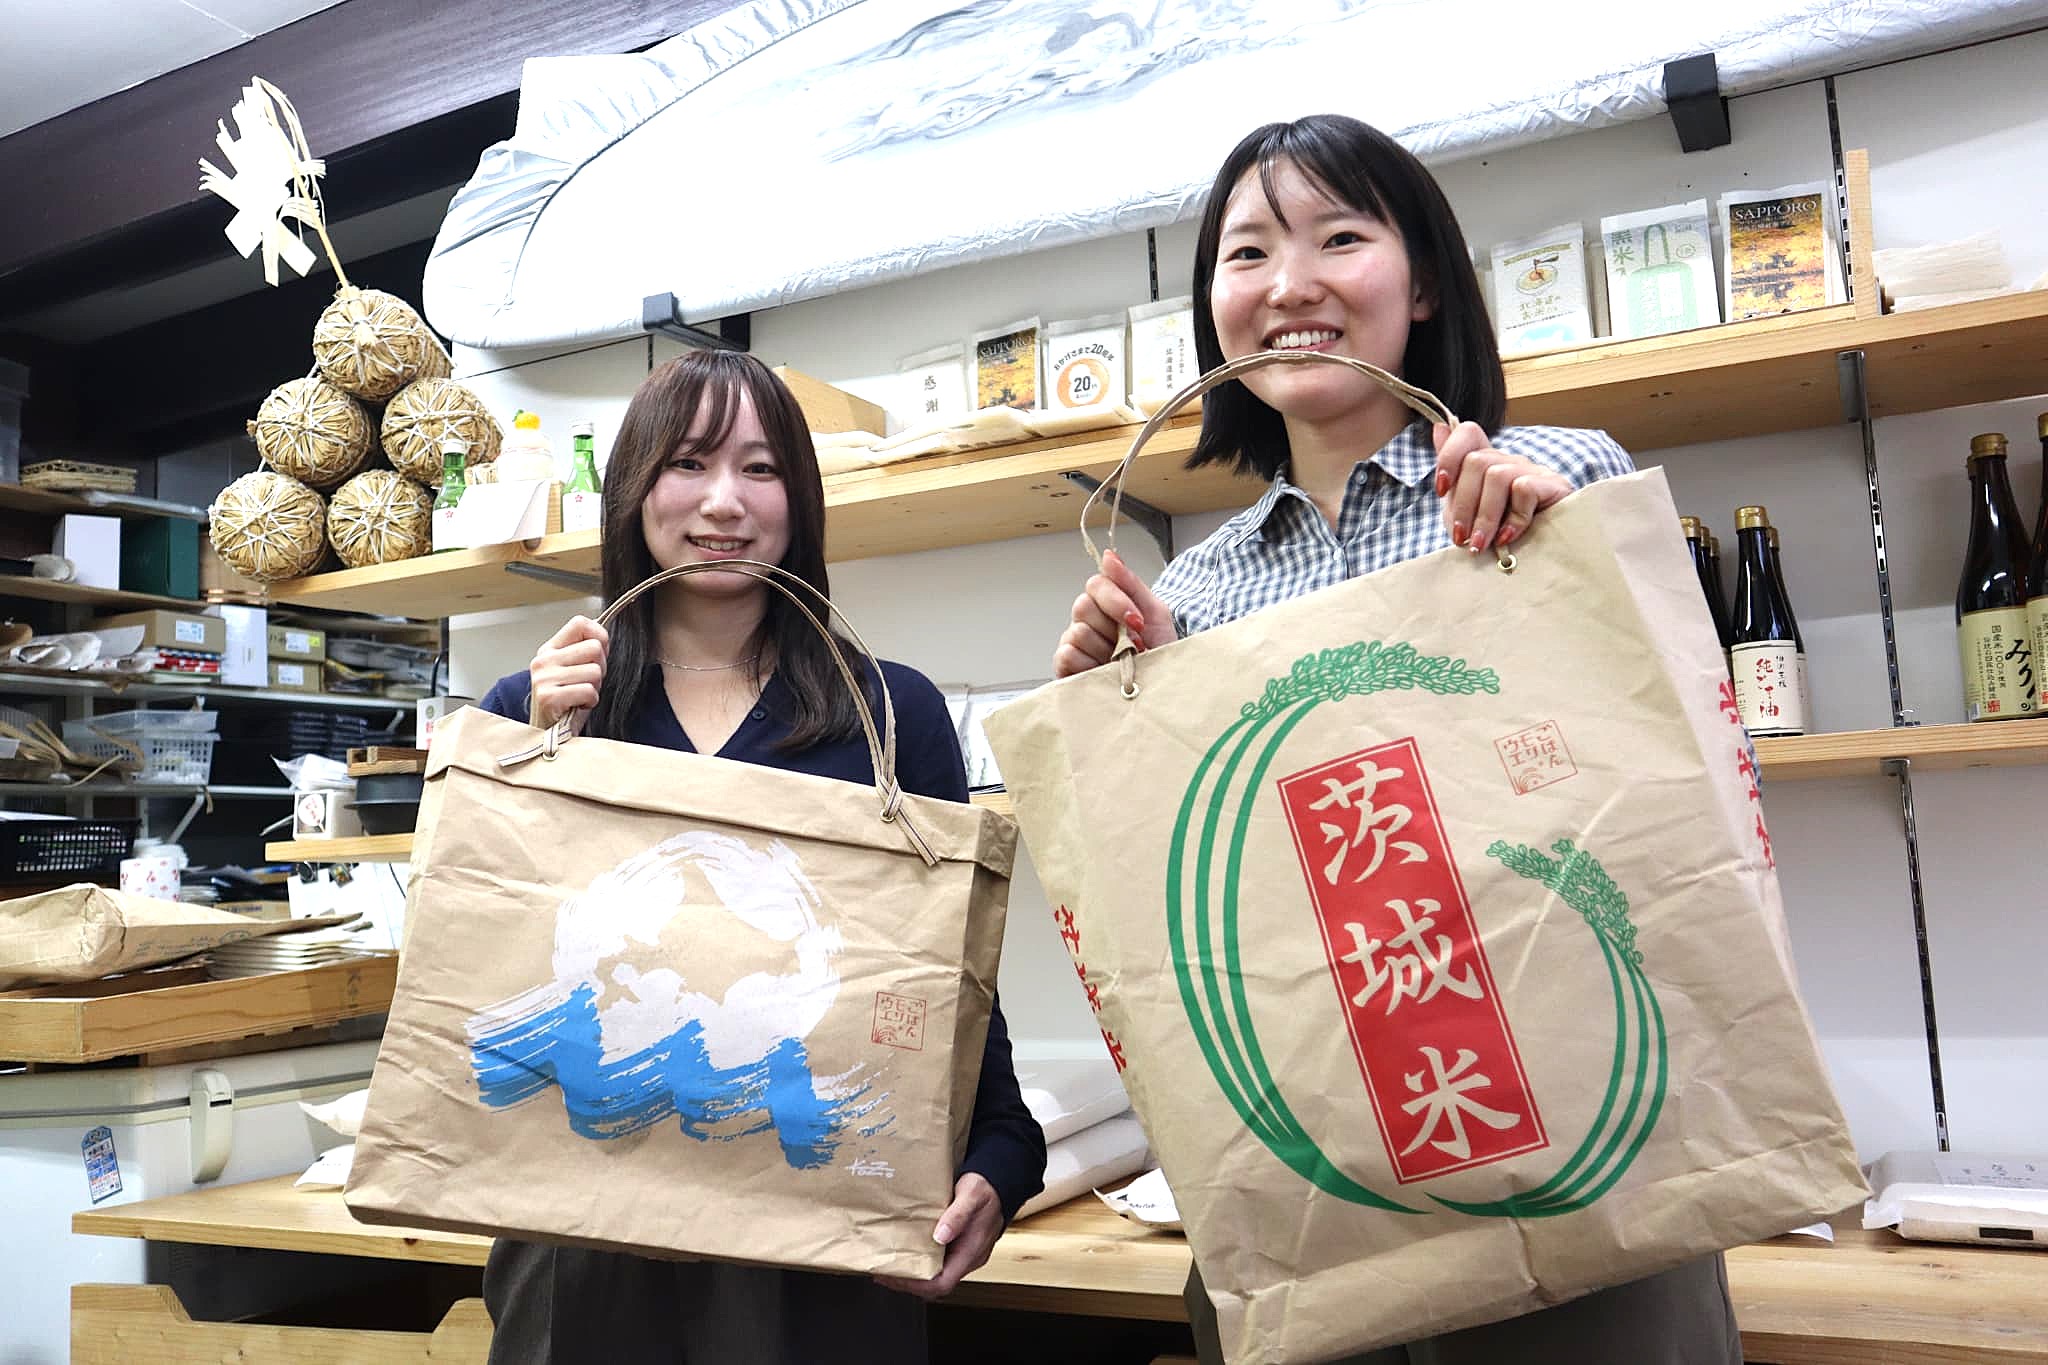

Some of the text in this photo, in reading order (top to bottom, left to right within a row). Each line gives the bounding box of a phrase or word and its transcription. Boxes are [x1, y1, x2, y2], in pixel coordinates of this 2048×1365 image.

[1735, 200, 1818, 220] SAPPORO
[1536, 723, 1563, 768] ごはん
[1308, 761, 1521, 1160] 茨城米
[904, 1001, 924, 1039] ごはん
